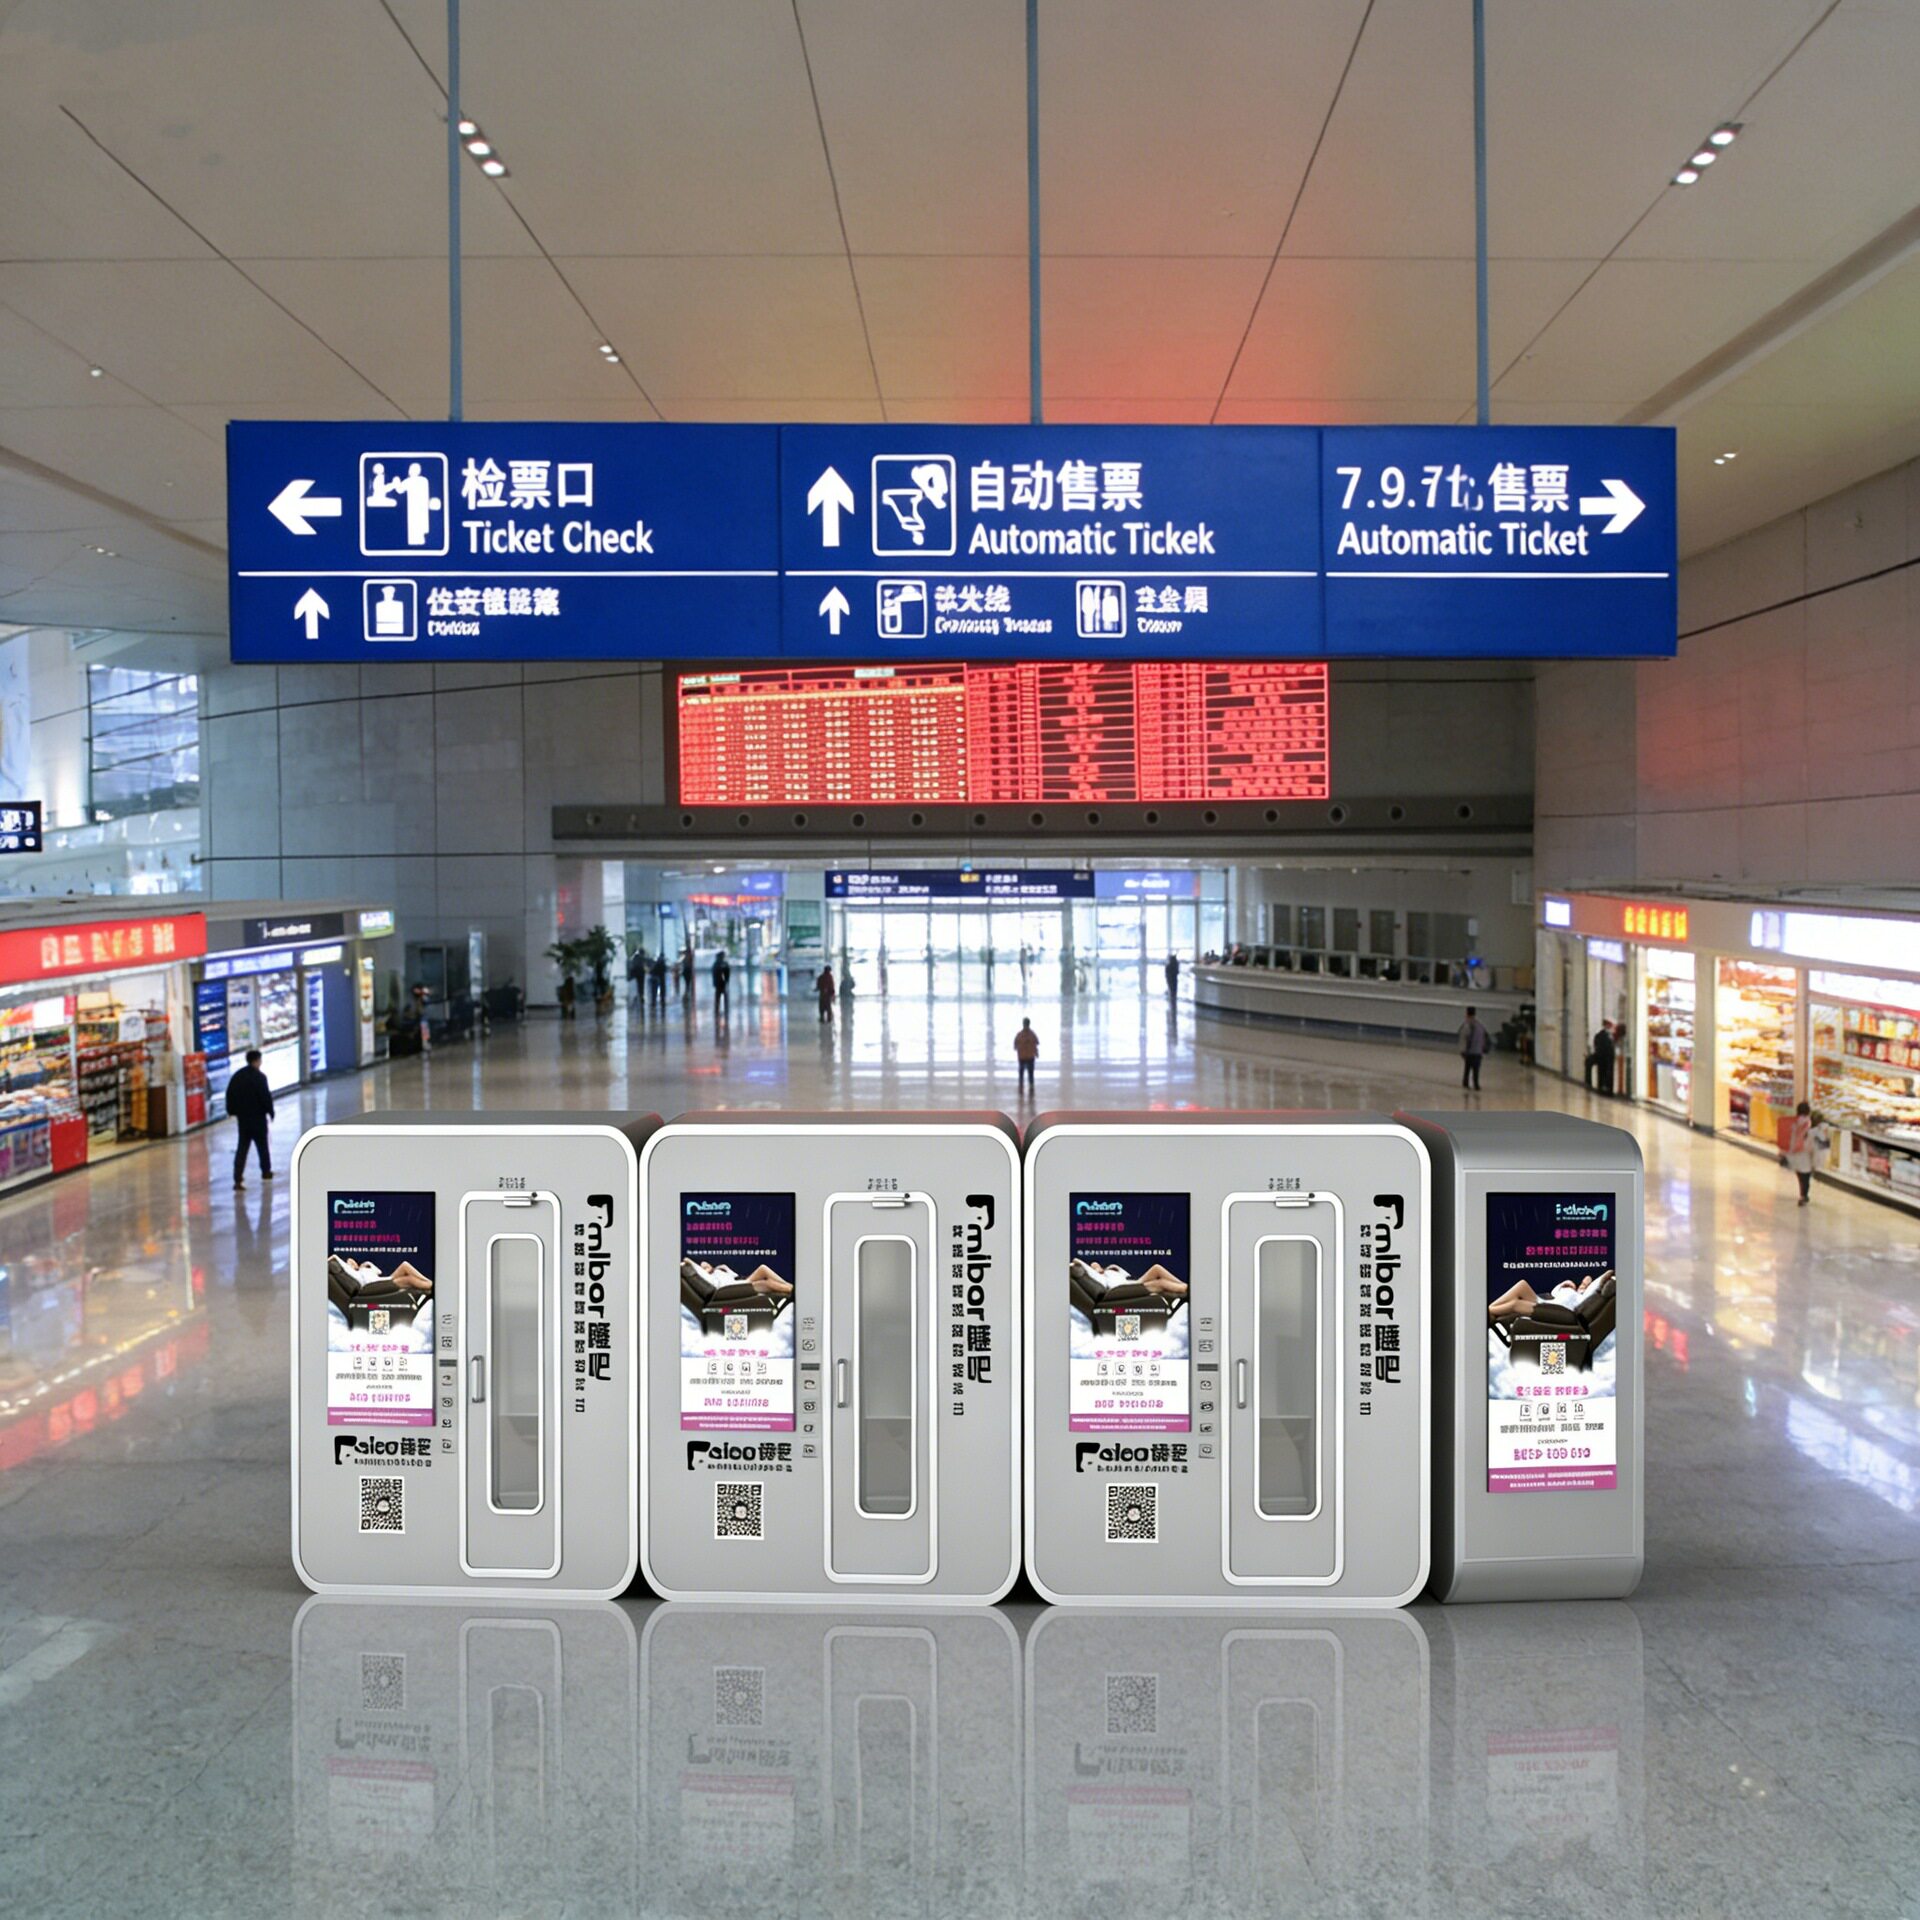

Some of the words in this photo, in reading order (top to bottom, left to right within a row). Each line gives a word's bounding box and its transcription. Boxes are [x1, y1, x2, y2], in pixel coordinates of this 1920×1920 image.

[461, 457, 593, 510] 检票口
[971, 460, 1143, 512] 自动售票
[462, 520, 555, 555] Ticket
[562, 520, 654, 555] Check
[968, 522, 1117, 556] Automatic
[1336, 522, 1493, 556] Automatic
[1499, 521, 1589, 556] Ticket
